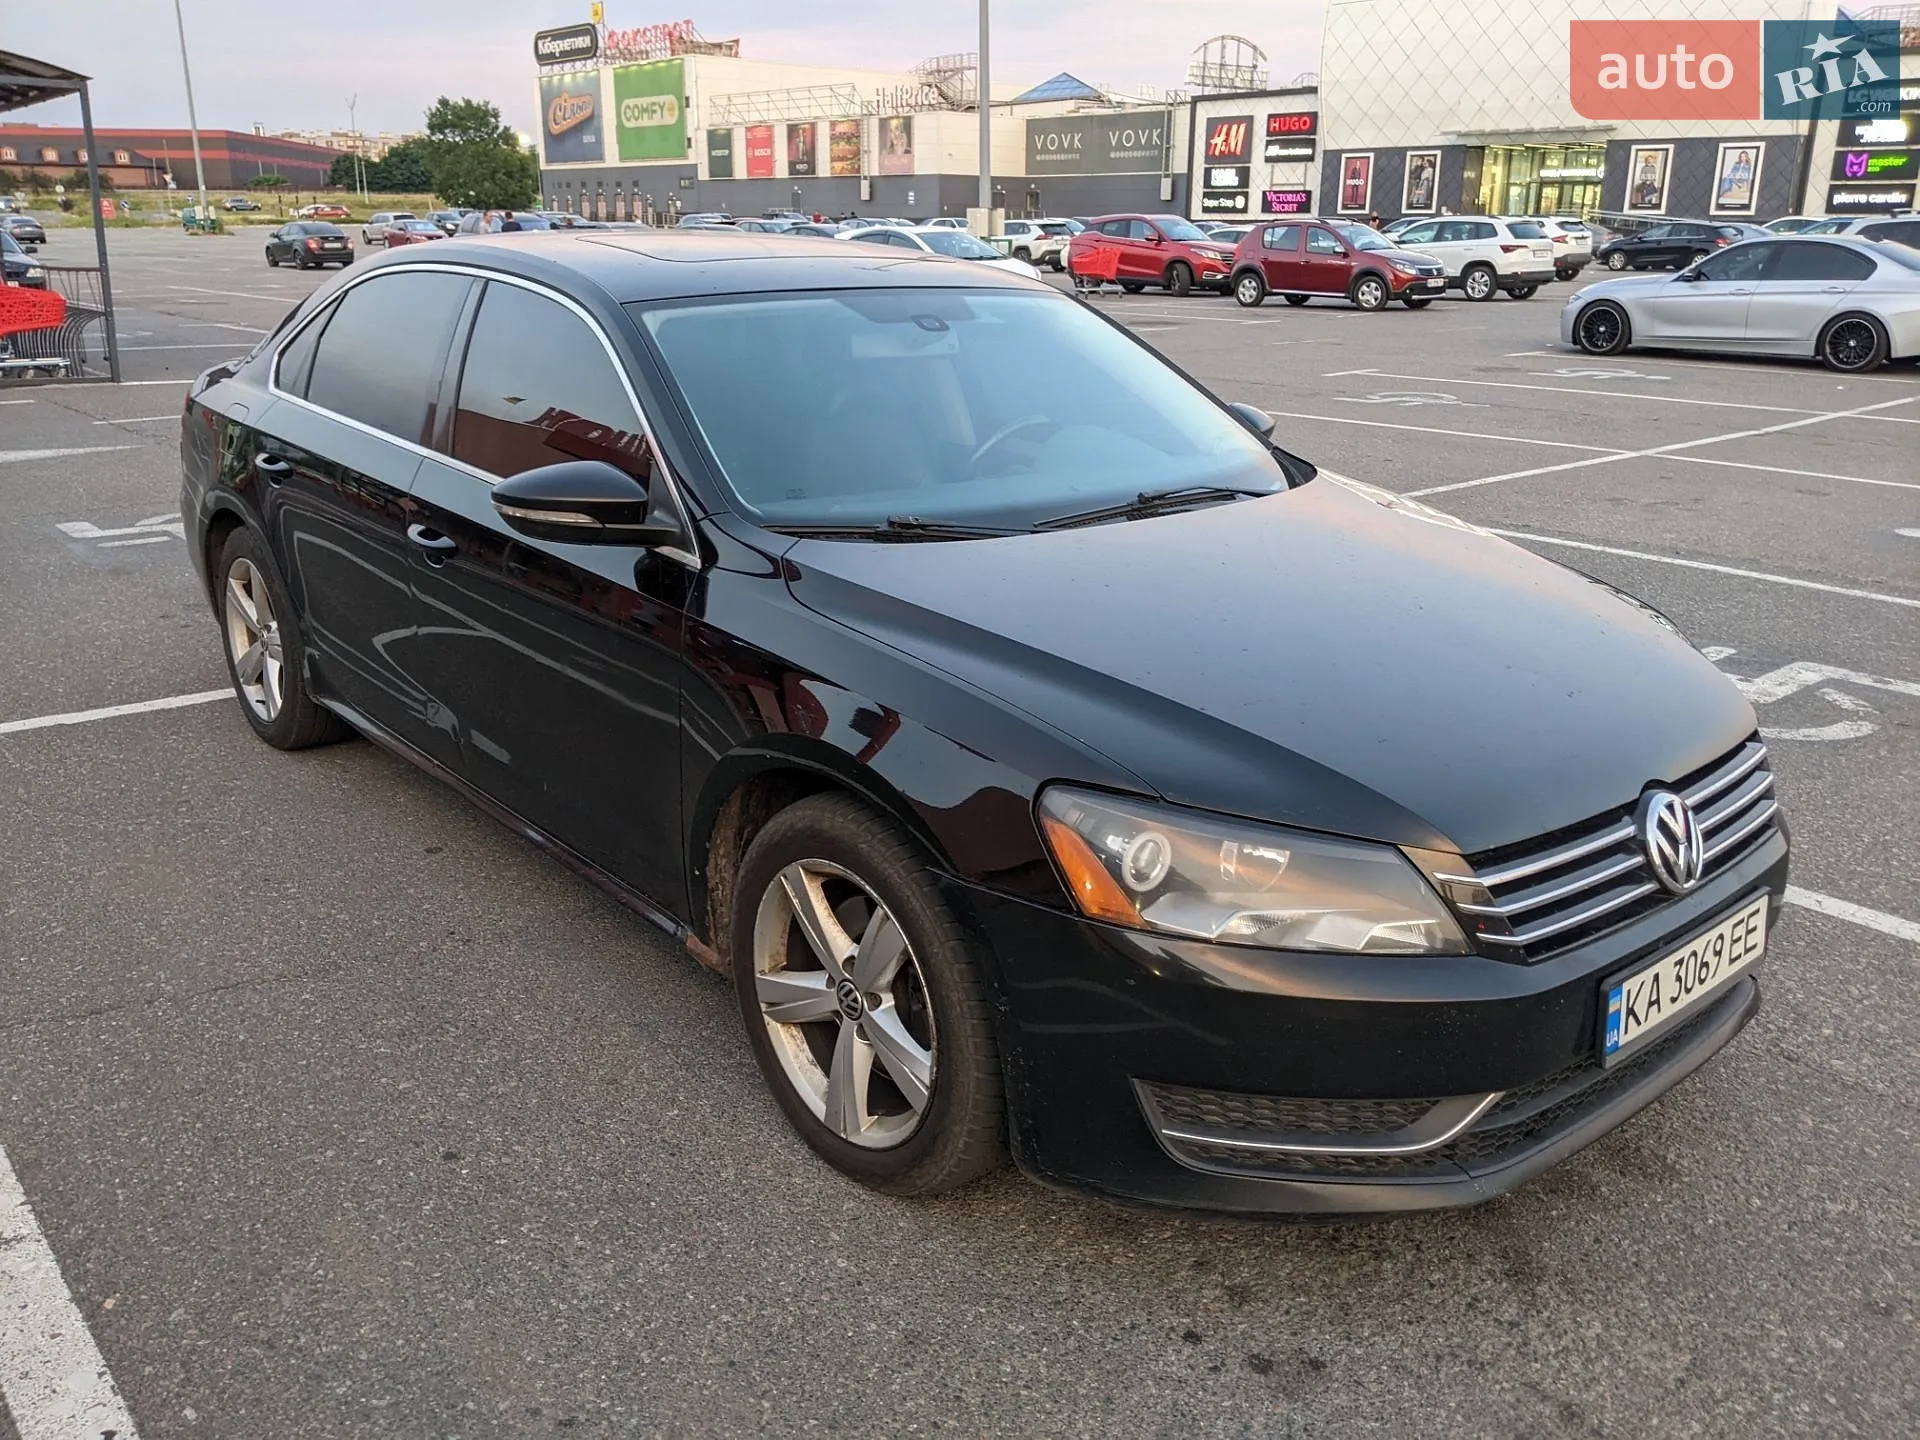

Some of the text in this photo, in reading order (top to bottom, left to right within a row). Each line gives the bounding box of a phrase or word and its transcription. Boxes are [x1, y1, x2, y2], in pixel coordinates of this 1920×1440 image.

[623, 102, 666, 121] COMFY
[1269, 116, 1311, 132] HUGO
[1035, 132, 1082, 150] VOVK
[1109, 128, 1161, 148] VOVK
[1208, 122, 1247, 156] H&M
[1832, 192, 1907, 205] pierre cardin
[1624, 907, 1761, 1036] KA 3069 EE
[1606, 1028, 1619, 1047] UA
